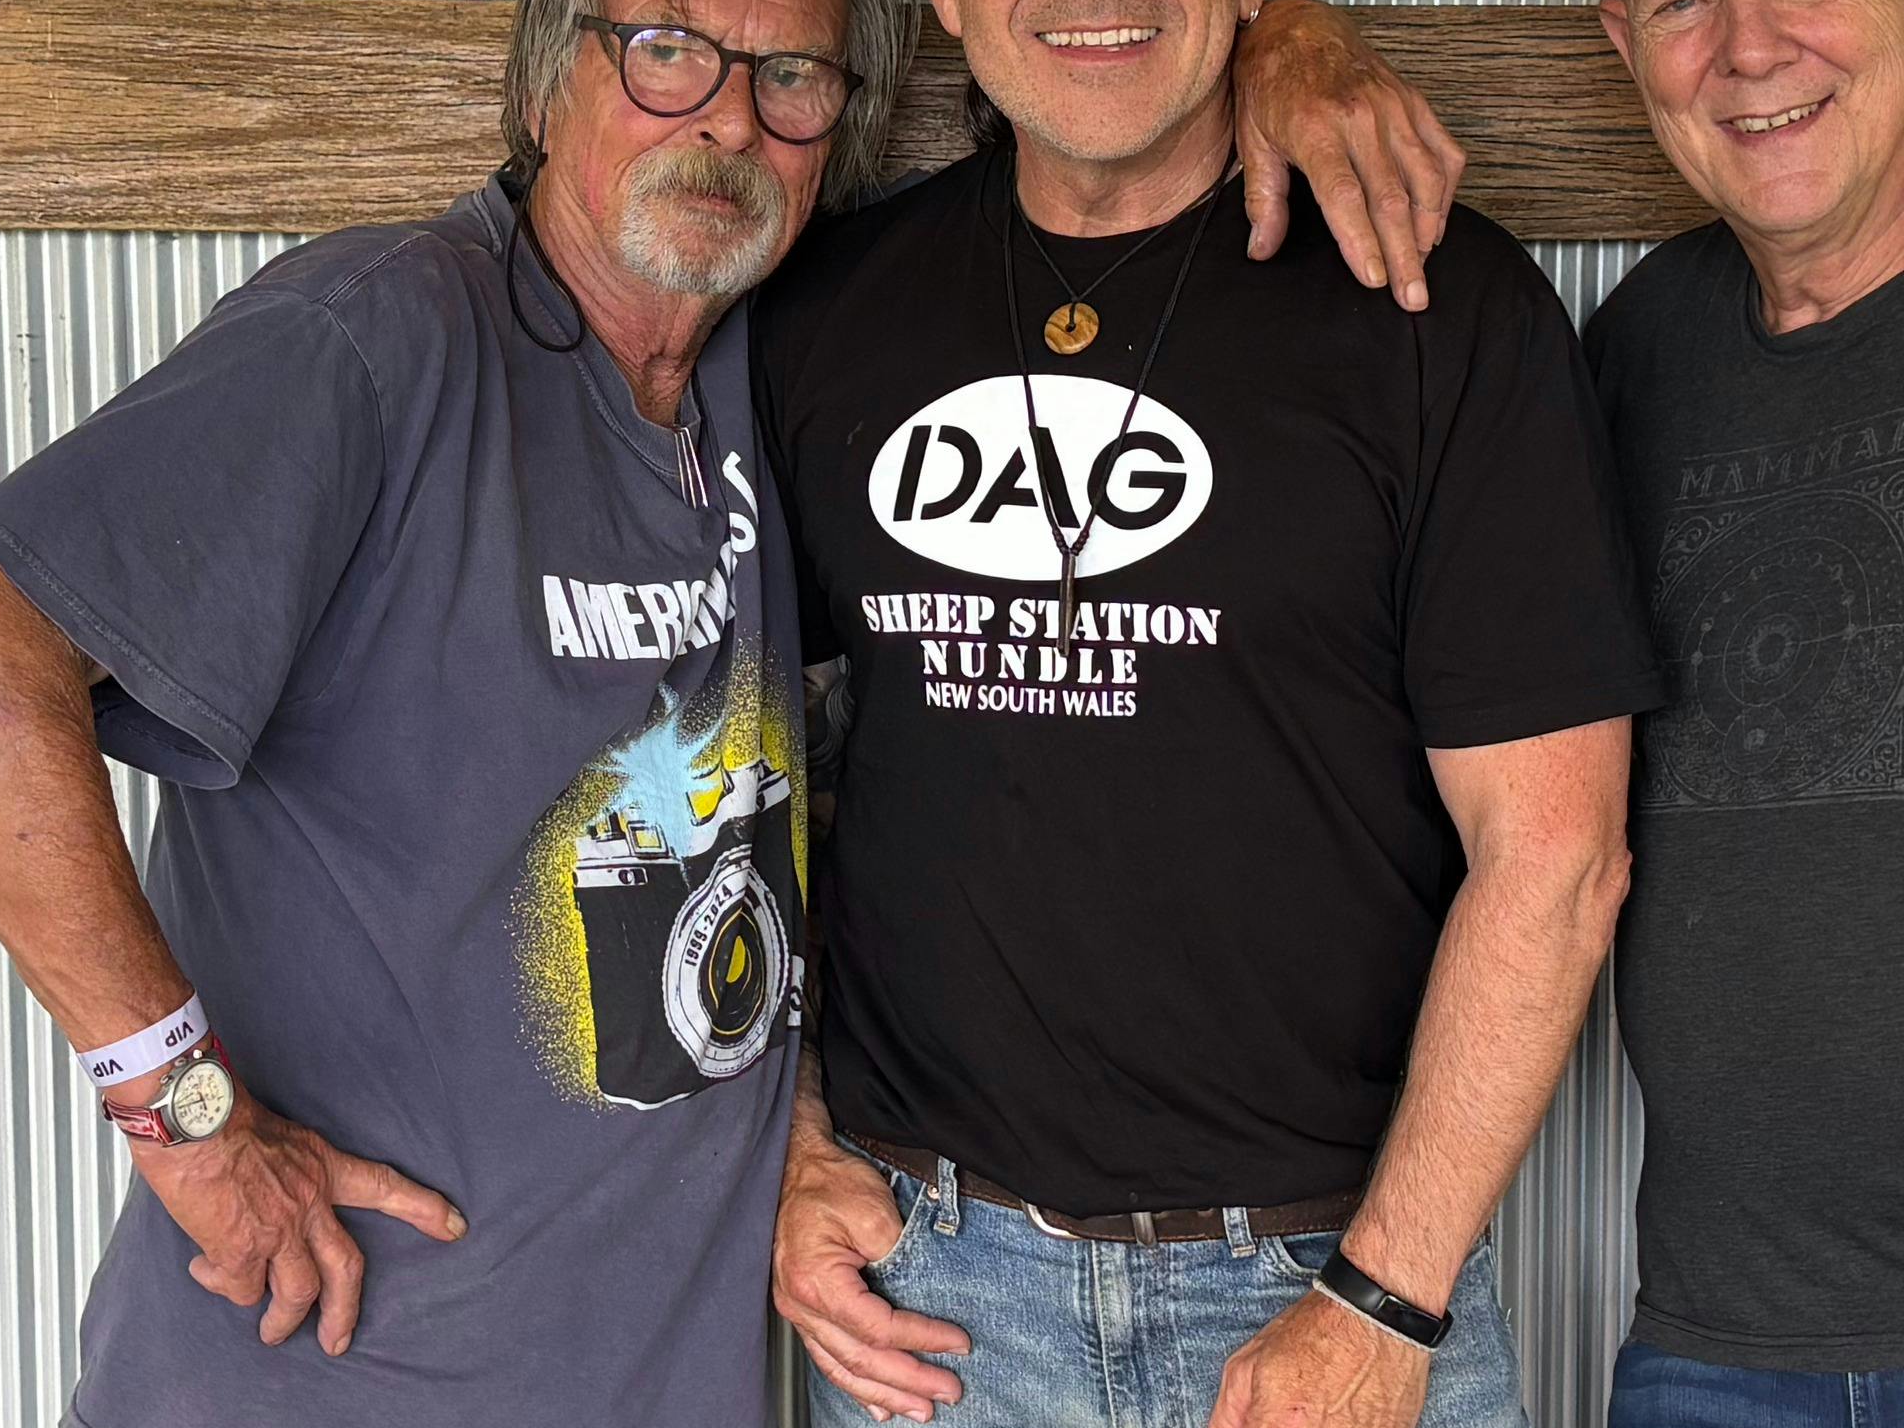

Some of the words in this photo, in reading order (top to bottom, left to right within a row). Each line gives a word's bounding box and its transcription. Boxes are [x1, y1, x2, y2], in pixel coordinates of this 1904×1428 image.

[893, 425, 1187, 530] DAG
[861, 593, 995, 635] SHEEP
[1009, 598, 1221, 645] STATION
[922, 640, 1138, 684] NUNDLE
[925, 681, 974, 710] NEW
[977, 684, 1056, 714] SOUTH
[1062, 687, 1137, 717] WALES
[684, 883, 733, 967] 1999-2024
[165, 1021, 195, 1048] VIP
[93, 1059, 124, 1078] VIP
